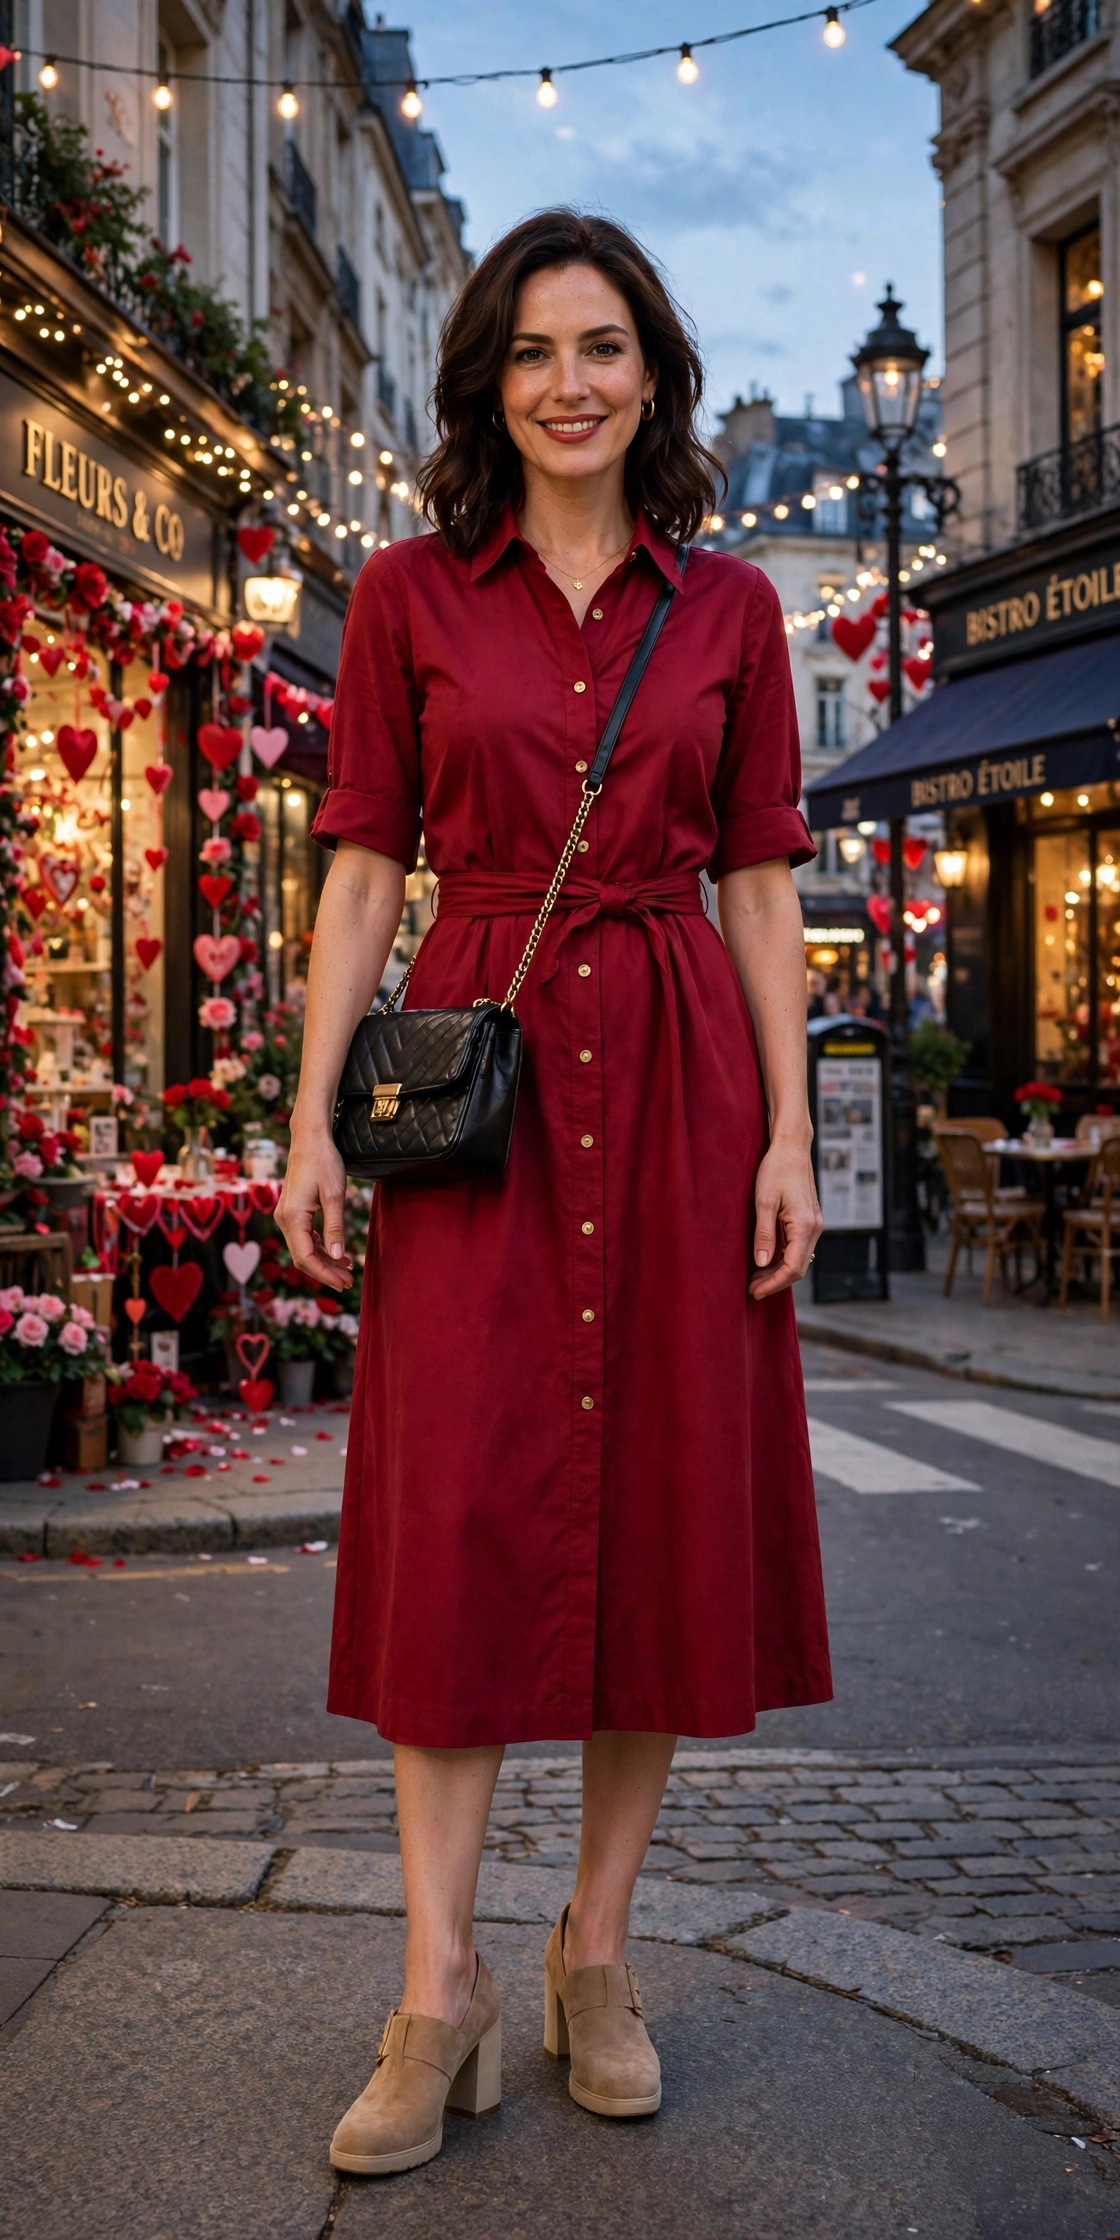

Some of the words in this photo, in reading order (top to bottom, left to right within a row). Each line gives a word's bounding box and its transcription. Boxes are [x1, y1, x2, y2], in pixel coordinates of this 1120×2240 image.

[24, 418, 128, 528] FLEURS
[133, 490, 150, 542] &
[155, 504, 184, 561] CO
[966, 591, 1040, 647] BISTRO
[911, 769, 974, 808] BISTRO
[977, 754, 1046, 796] ÉTOILE
